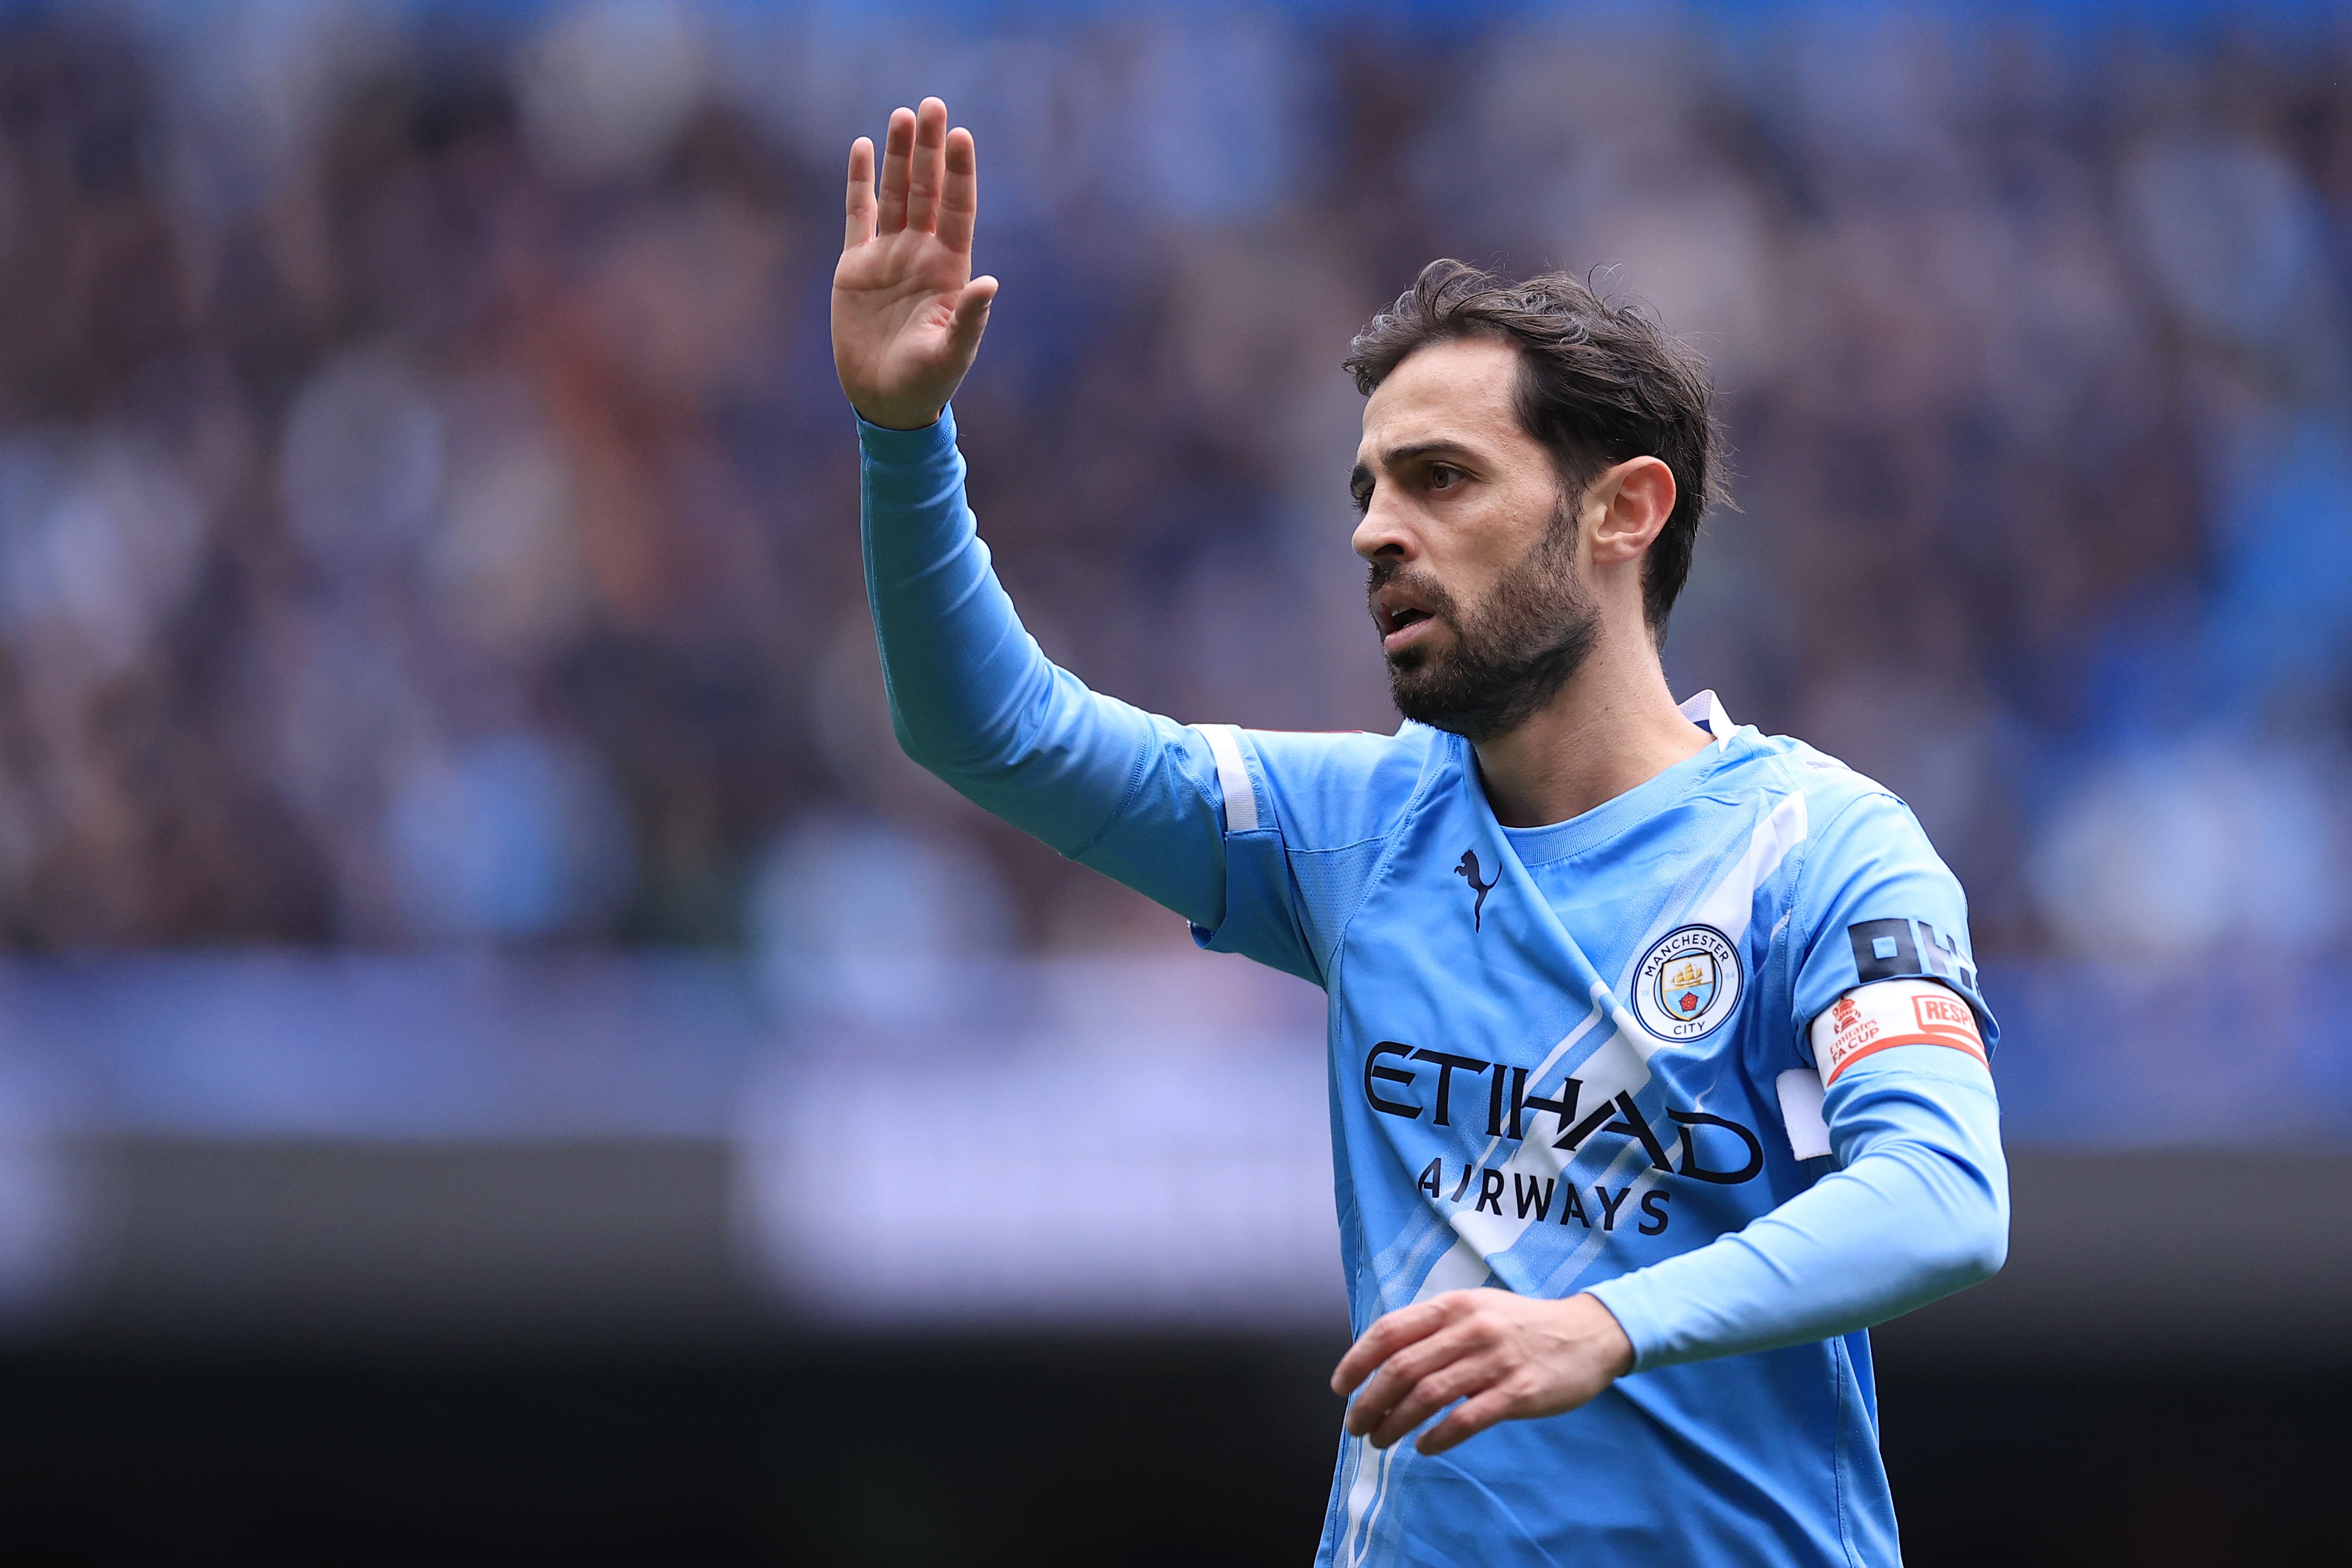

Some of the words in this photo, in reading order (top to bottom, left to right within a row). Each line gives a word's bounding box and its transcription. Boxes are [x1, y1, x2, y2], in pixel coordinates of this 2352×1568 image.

[1644, 934, 1729, 977] MANCHESTER
[1725, 972, 1735, 980] 94
[1673, 1021, 1706, 1035] CITY
[1830, 1019, 1877, 1055] Emirates
[1832, 1048, 1846, 1065] FA
[1848, 1027, 1880, 1049] CUP
[1364, 1040, 1764, 1185] ETIHAD
[1417, 1157, 1670, 1237] AIRWAYS
